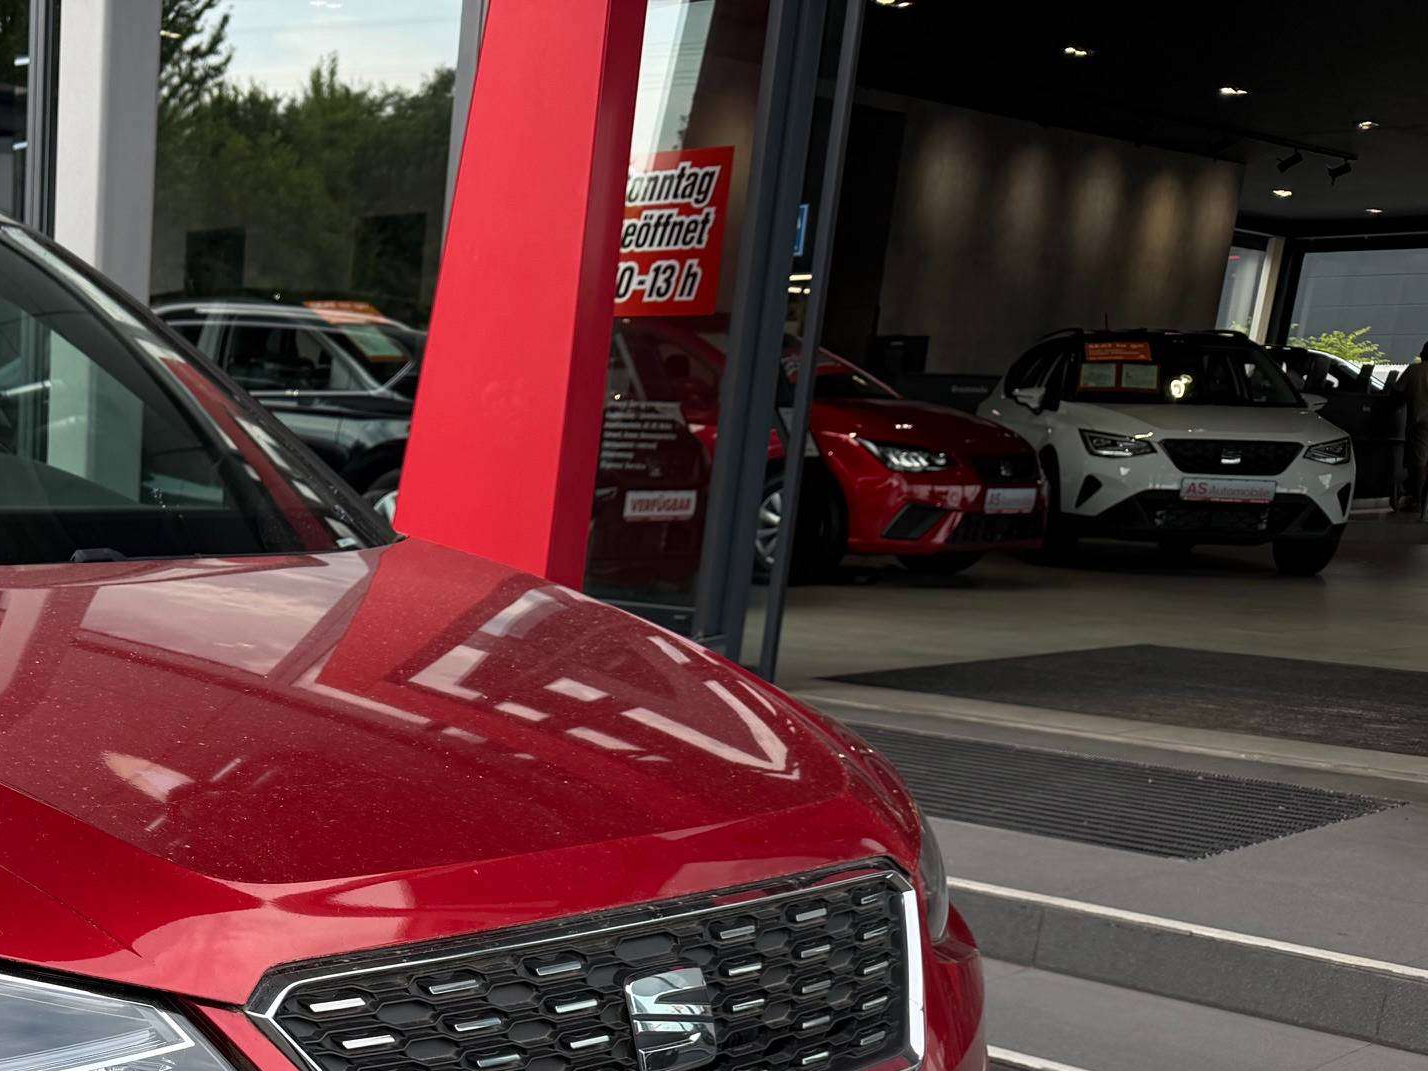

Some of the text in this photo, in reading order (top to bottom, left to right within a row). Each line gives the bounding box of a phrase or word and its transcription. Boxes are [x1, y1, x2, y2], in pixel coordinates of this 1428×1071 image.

[626, 163, 718, 204] onntag
[621, 210, 714, 250] eöffnet
[615, 261, 700, 300] 0-13 h
[1186, 482, 1270, 498] AS Automobile
